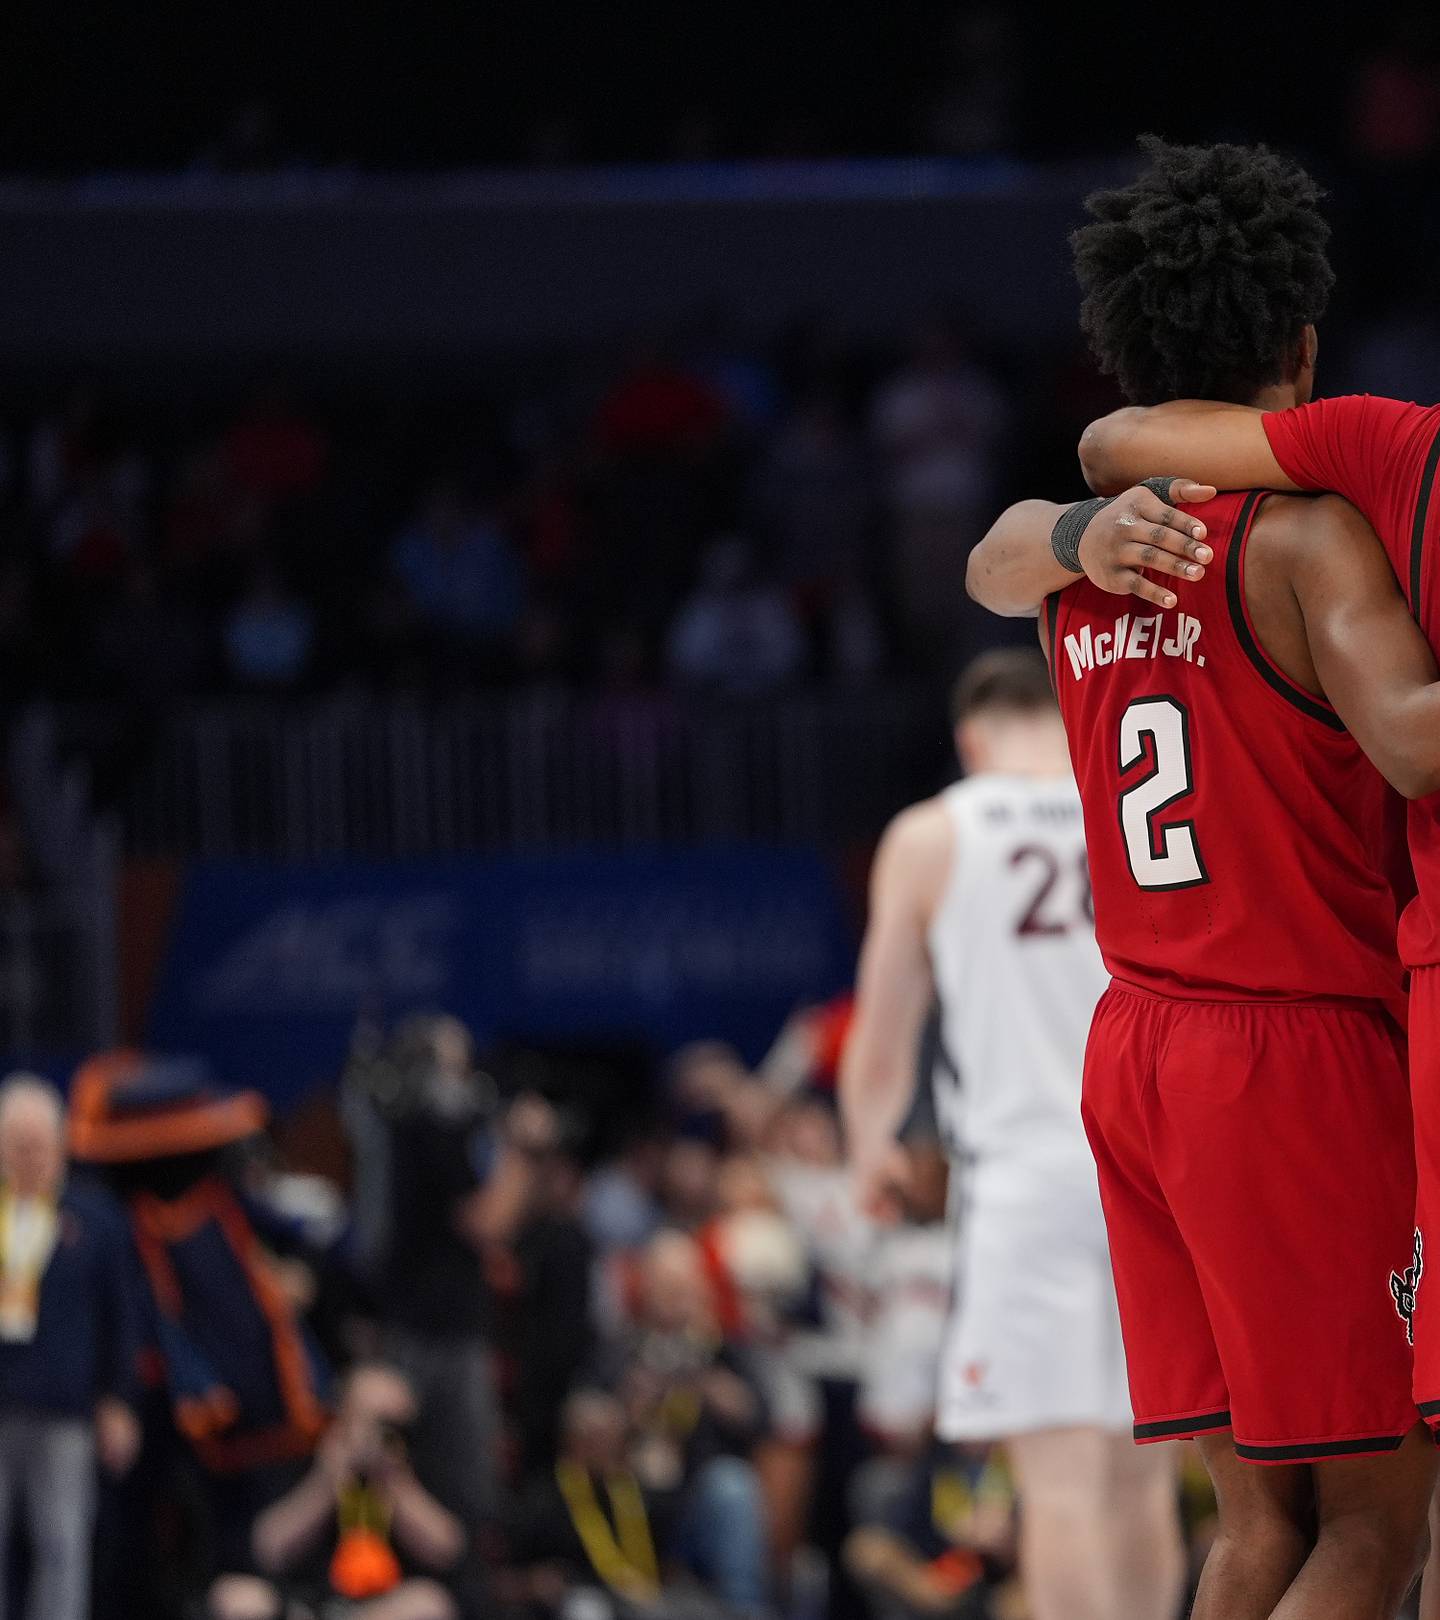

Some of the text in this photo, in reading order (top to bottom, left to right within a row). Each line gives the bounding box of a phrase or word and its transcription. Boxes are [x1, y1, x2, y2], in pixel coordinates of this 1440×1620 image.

[1064, 612, 1206, 681] McNEI JR.
[1118, 694, 1211, 892] 2
